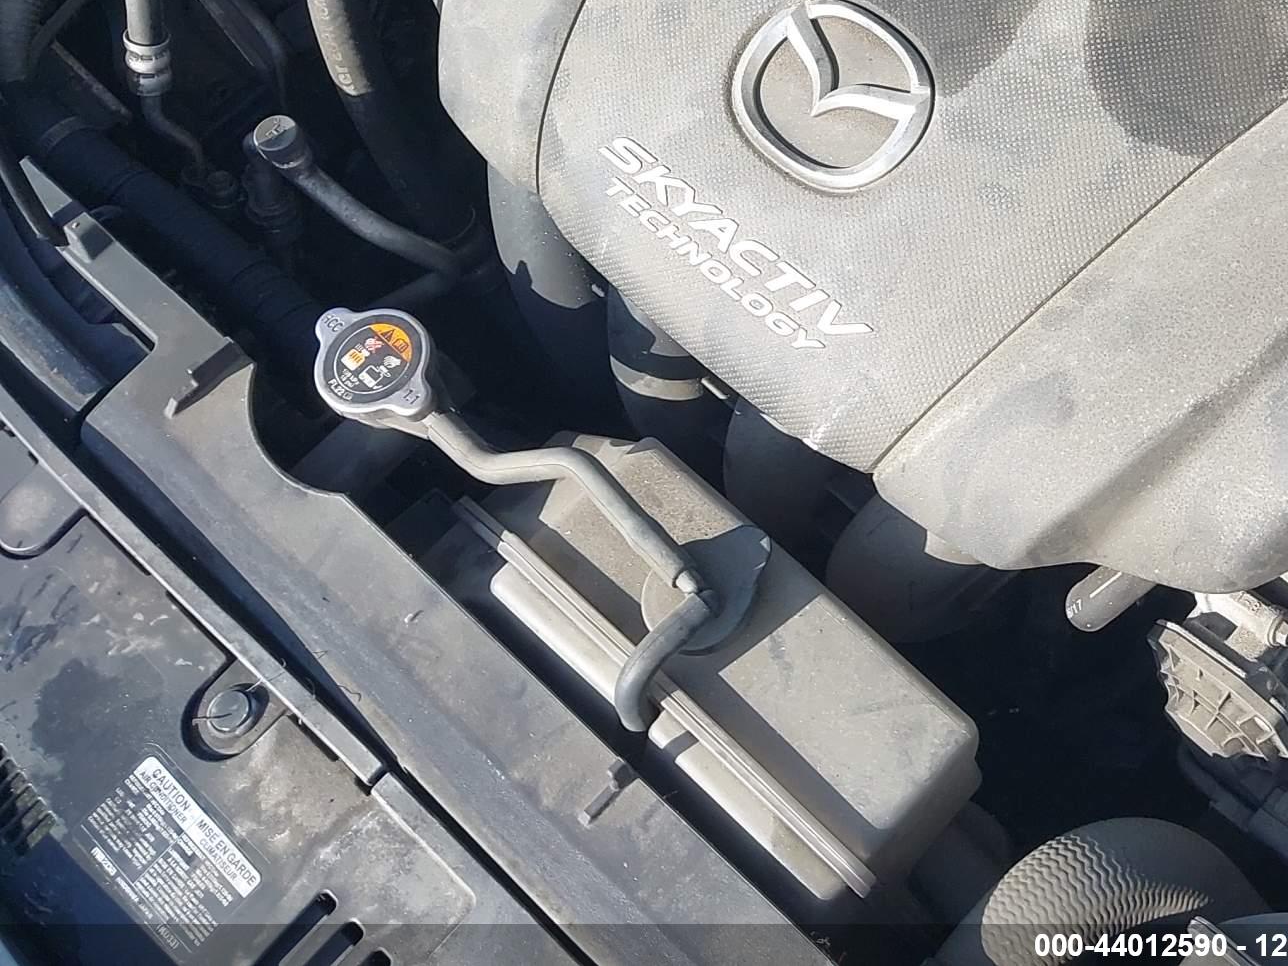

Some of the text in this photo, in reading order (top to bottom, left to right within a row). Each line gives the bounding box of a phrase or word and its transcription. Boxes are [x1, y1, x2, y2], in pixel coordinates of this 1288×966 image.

[598, 135, 875, 336] SKYACTIV
[605, 176, 827, 349] TECHNOLOGY
[328, 378, 346, 396] FL22
[138, 769, 152, 784] AIR
[148, 779, 188, 825] CONDITIONER
[153, 769, 190, 811] CAUTION
[195, 818, 219, 844] MISE
[214, 839, 230, 856] EN
[225, 851, 257, 886] GARDE
[198, 837, 238, 882] CLIMATISEUR
